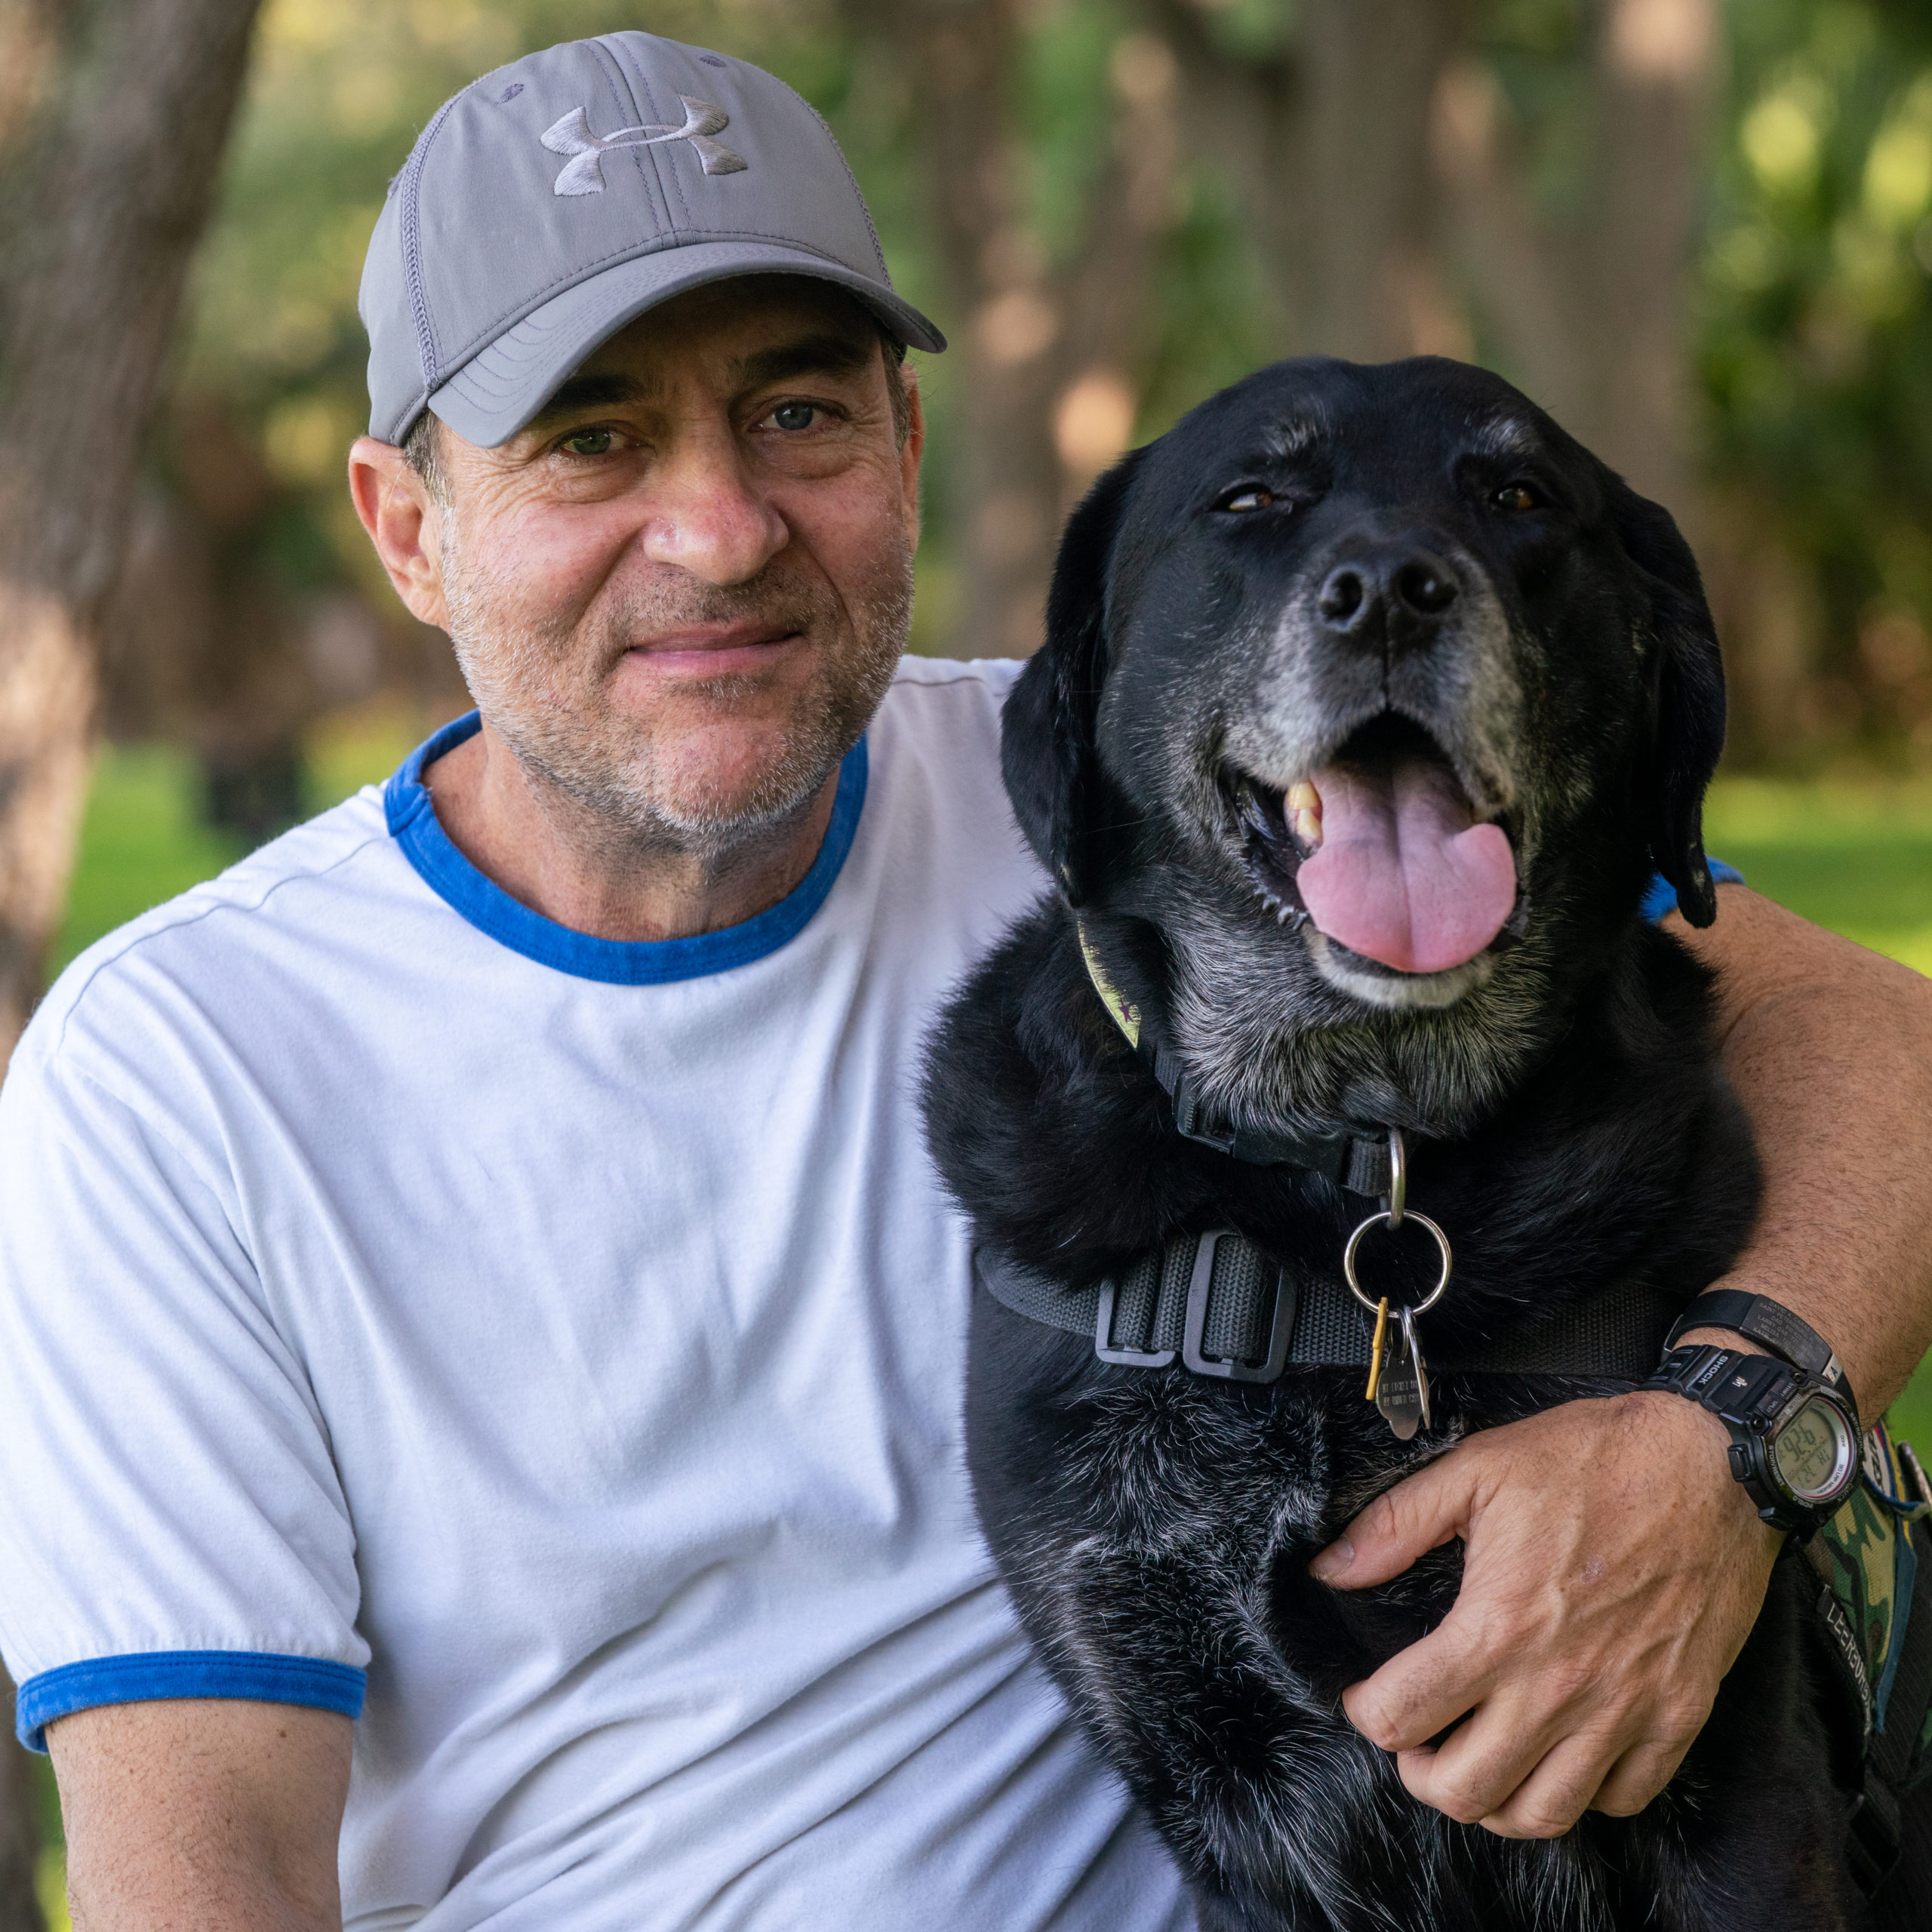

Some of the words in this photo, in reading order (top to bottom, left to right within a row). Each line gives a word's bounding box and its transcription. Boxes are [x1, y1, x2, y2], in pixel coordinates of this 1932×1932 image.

[1757, 1315, 1776, 1328] LARRY
[1698, 1355, 1728, 1385] SHOCK
[1766, 1401, 1778, 1414] SPLIT
